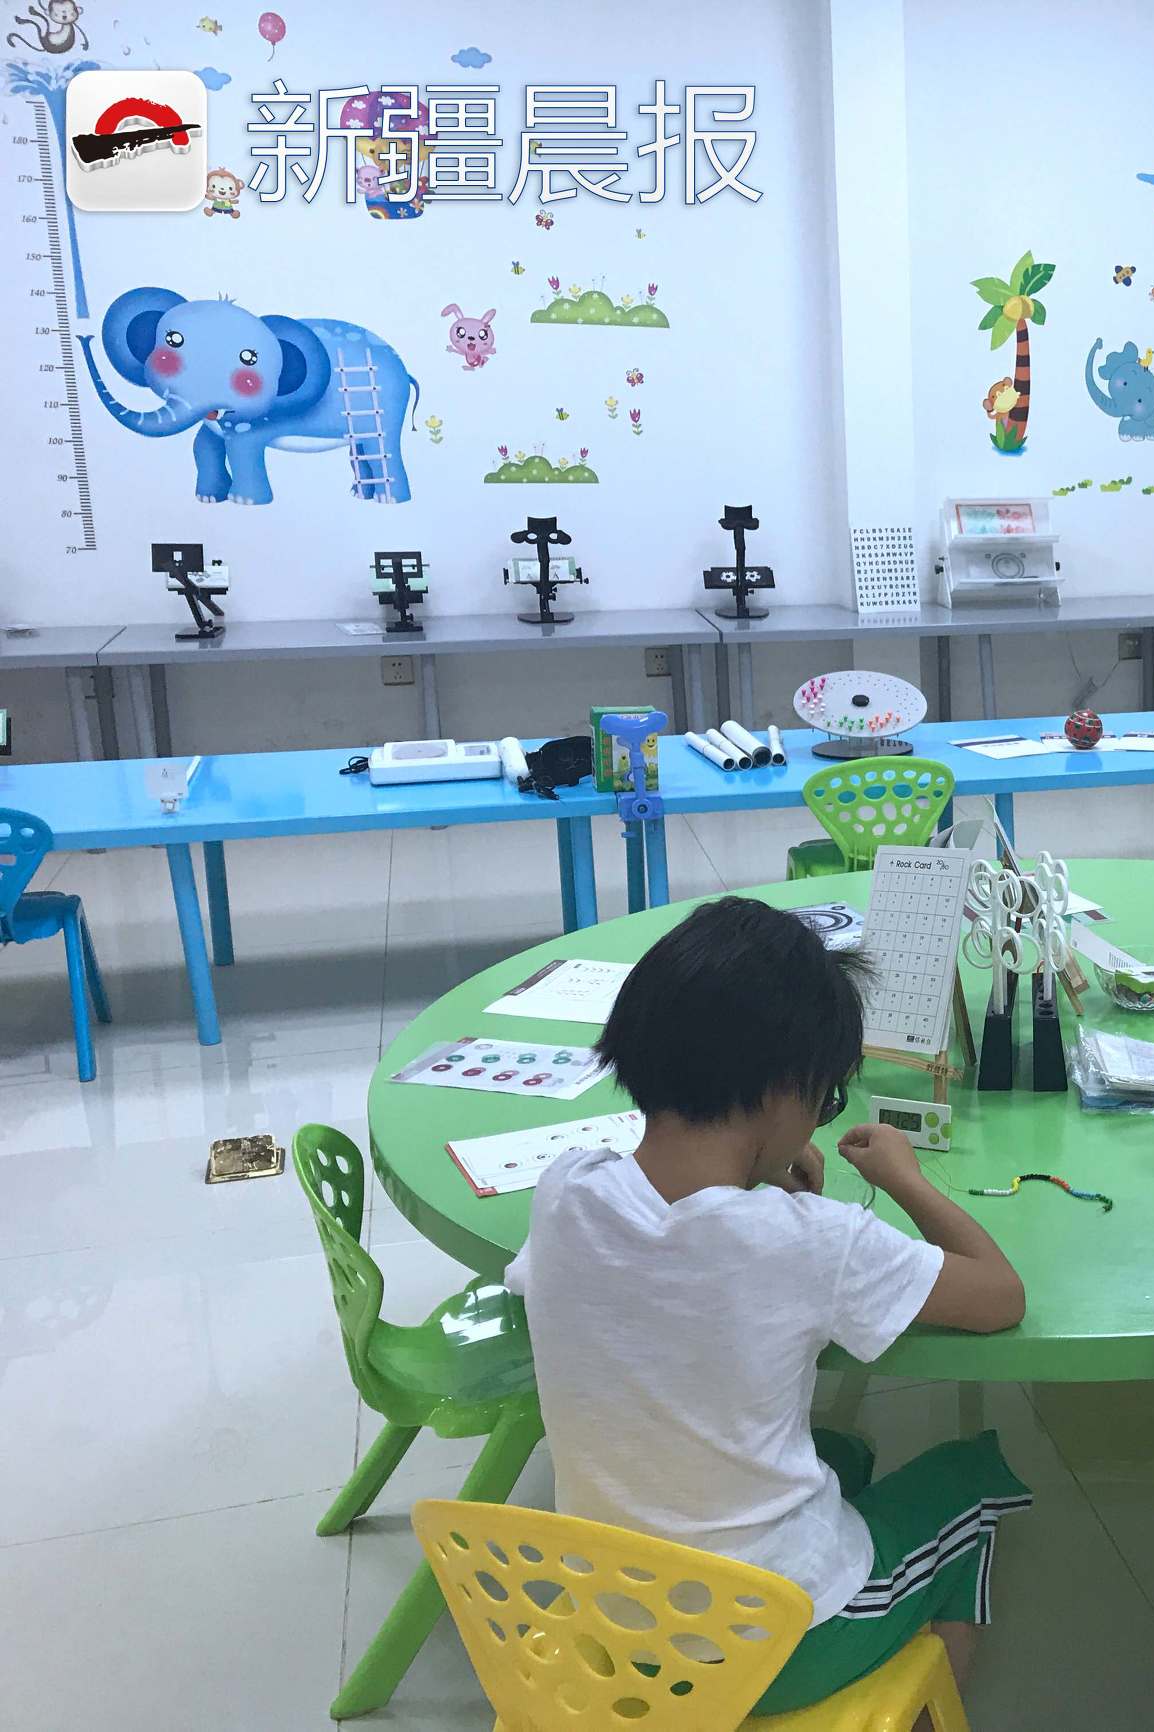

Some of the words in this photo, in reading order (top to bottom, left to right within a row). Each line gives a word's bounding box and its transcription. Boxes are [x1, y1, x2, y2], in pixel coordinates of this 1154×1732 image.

[12, 137, 28, 145] 180
[17, 175, 33, 183] 170
[22, 215, 37, 223] 160
[26, 252, 42, 261] 150
[30, 289, 45, 297] 140
[35, 327, 50, 335] 130
[39, 364, 54, 372] 120
[43, 401, 59, 409] 110
[48, 437, 63, 445] 100
[57, 474, 68, 482] 90
[61, 510, 72, 518] 80
[66, 546, 77, 554] 70
[896, 860, 912, 869] Rock
[914, 861, 932, 870] Card
